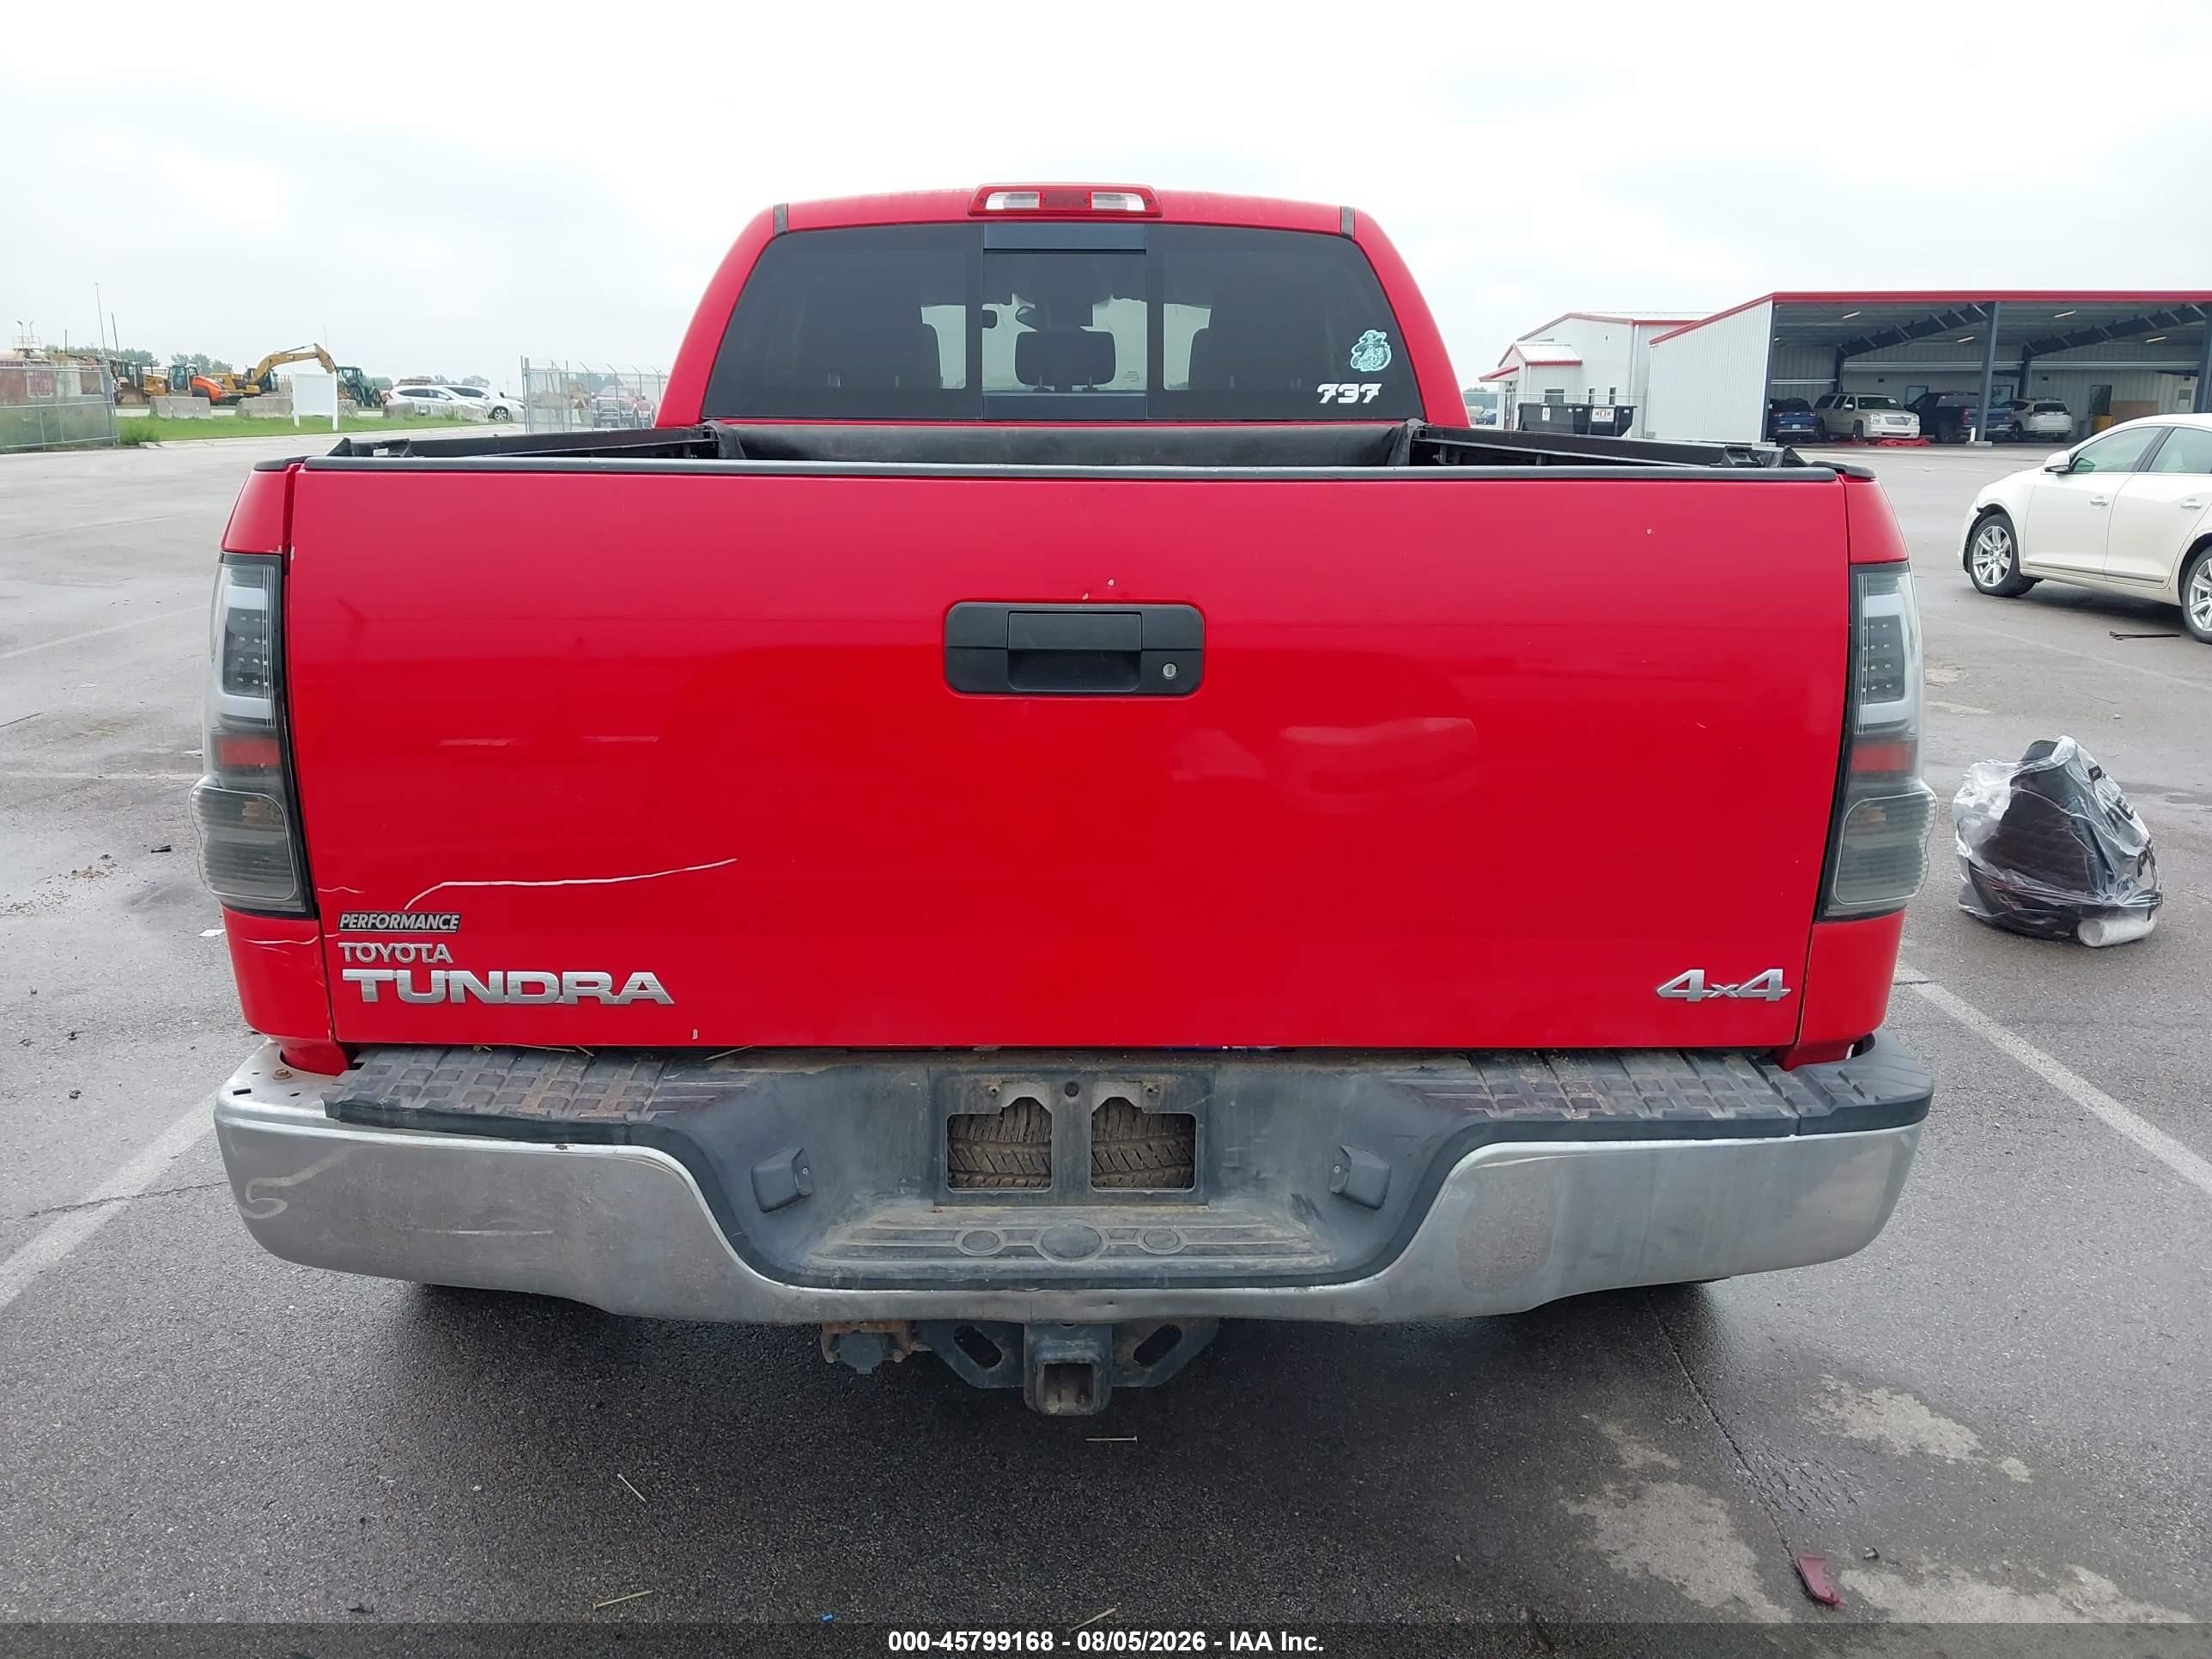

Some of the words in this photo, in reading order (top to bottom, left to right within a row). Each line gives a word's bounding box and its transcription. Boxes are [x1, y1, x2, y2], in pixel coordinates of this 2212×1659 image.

[1316, 383, 1382, 404] 737
[339, 913, 459, 930] PERFORMANCE
[338, 942, 453, 963] TOYOTA
[343, 969, 675, 1005] TUNDRA
[1656, 969, 1791, 1002] 4x4
